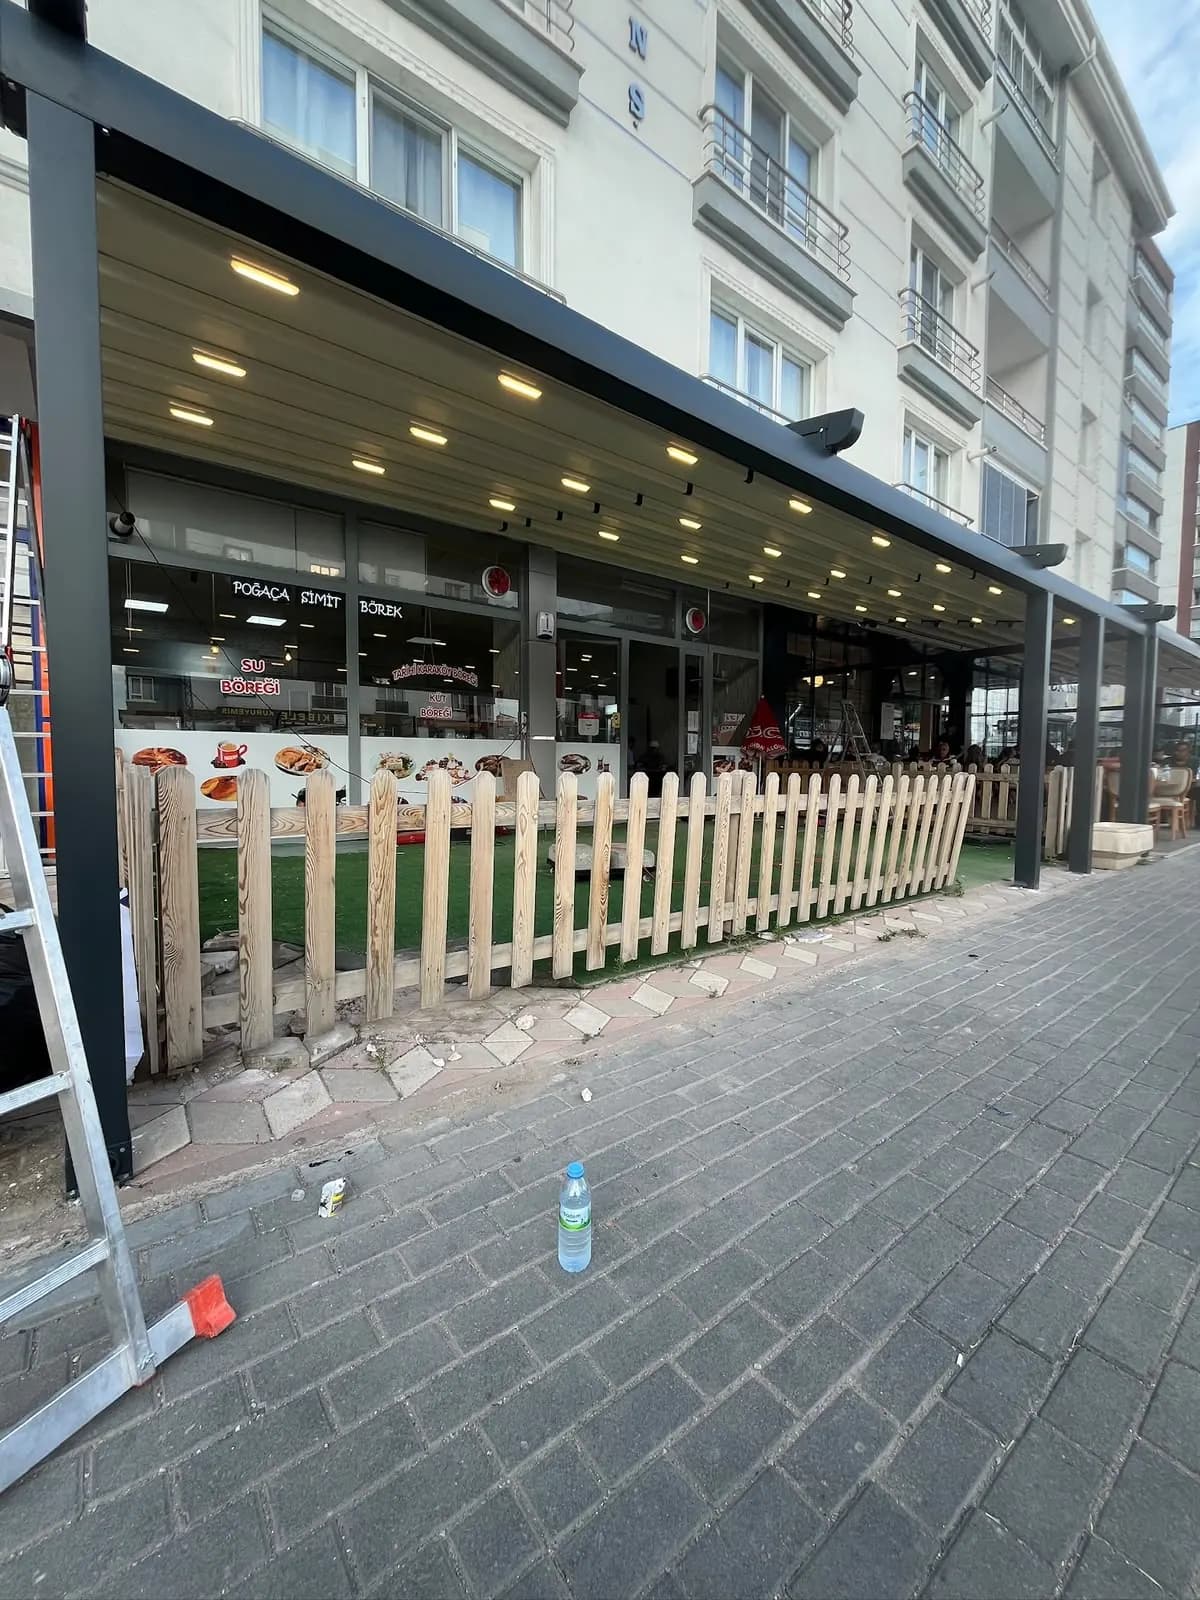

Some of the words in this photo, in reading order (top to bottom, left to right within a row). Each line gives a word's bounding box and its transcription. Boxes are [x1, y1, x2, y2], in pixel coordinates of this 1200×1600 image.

[232, 580, 290, 602] POĞAÇA
[300, 590, 342, 609] SİMİT
[359, 600, 403, 619] BÖREK
[241, 659, 265, 673] SU
[220, 677, 280, 695] BÖREĞİ
